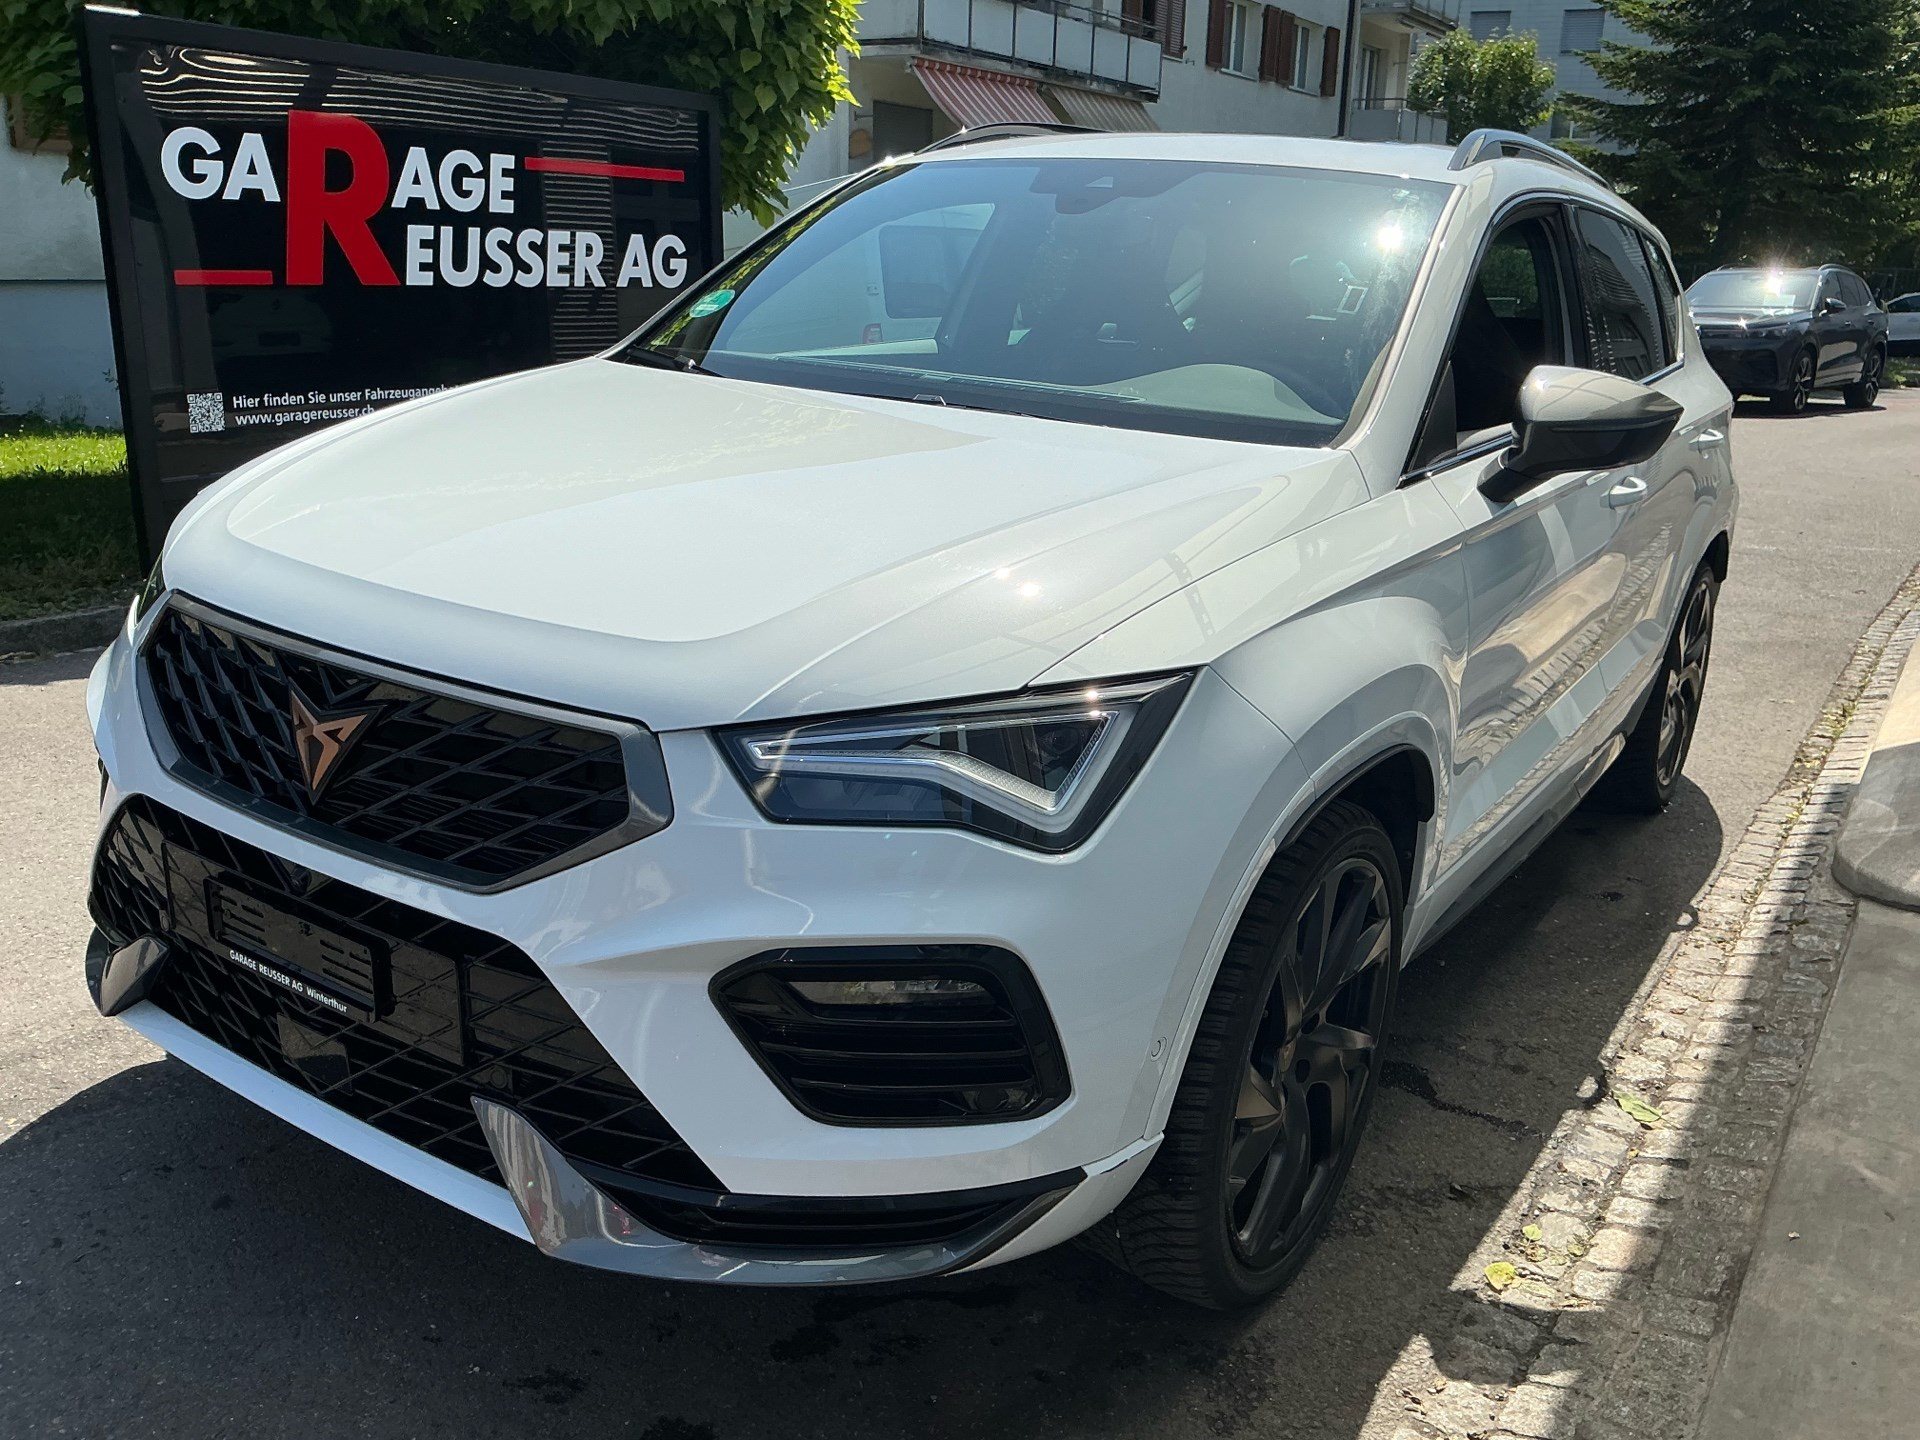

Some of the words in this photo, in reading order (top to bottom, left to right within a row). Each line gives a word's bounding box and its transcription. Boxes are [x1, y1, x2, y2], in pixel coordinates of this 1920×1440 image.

[160, 110, 516, 286] GARAGE
[616, 233, 688, 289] AG
[232, 394, 261, 409] Hier
[263, 392, 305, 407] finden
[307, 390, 327, 404] Sie
[329, 391, 362, 403] unser
[234, 403, 375, 426] www.garagereusser.ch
[229, 949, 257, 971] GARAGE
[258, 963, 291, 986] REUSSER
[291, 979, 304, 993] AG
[306, 986, 348, 1013] Winterthur
